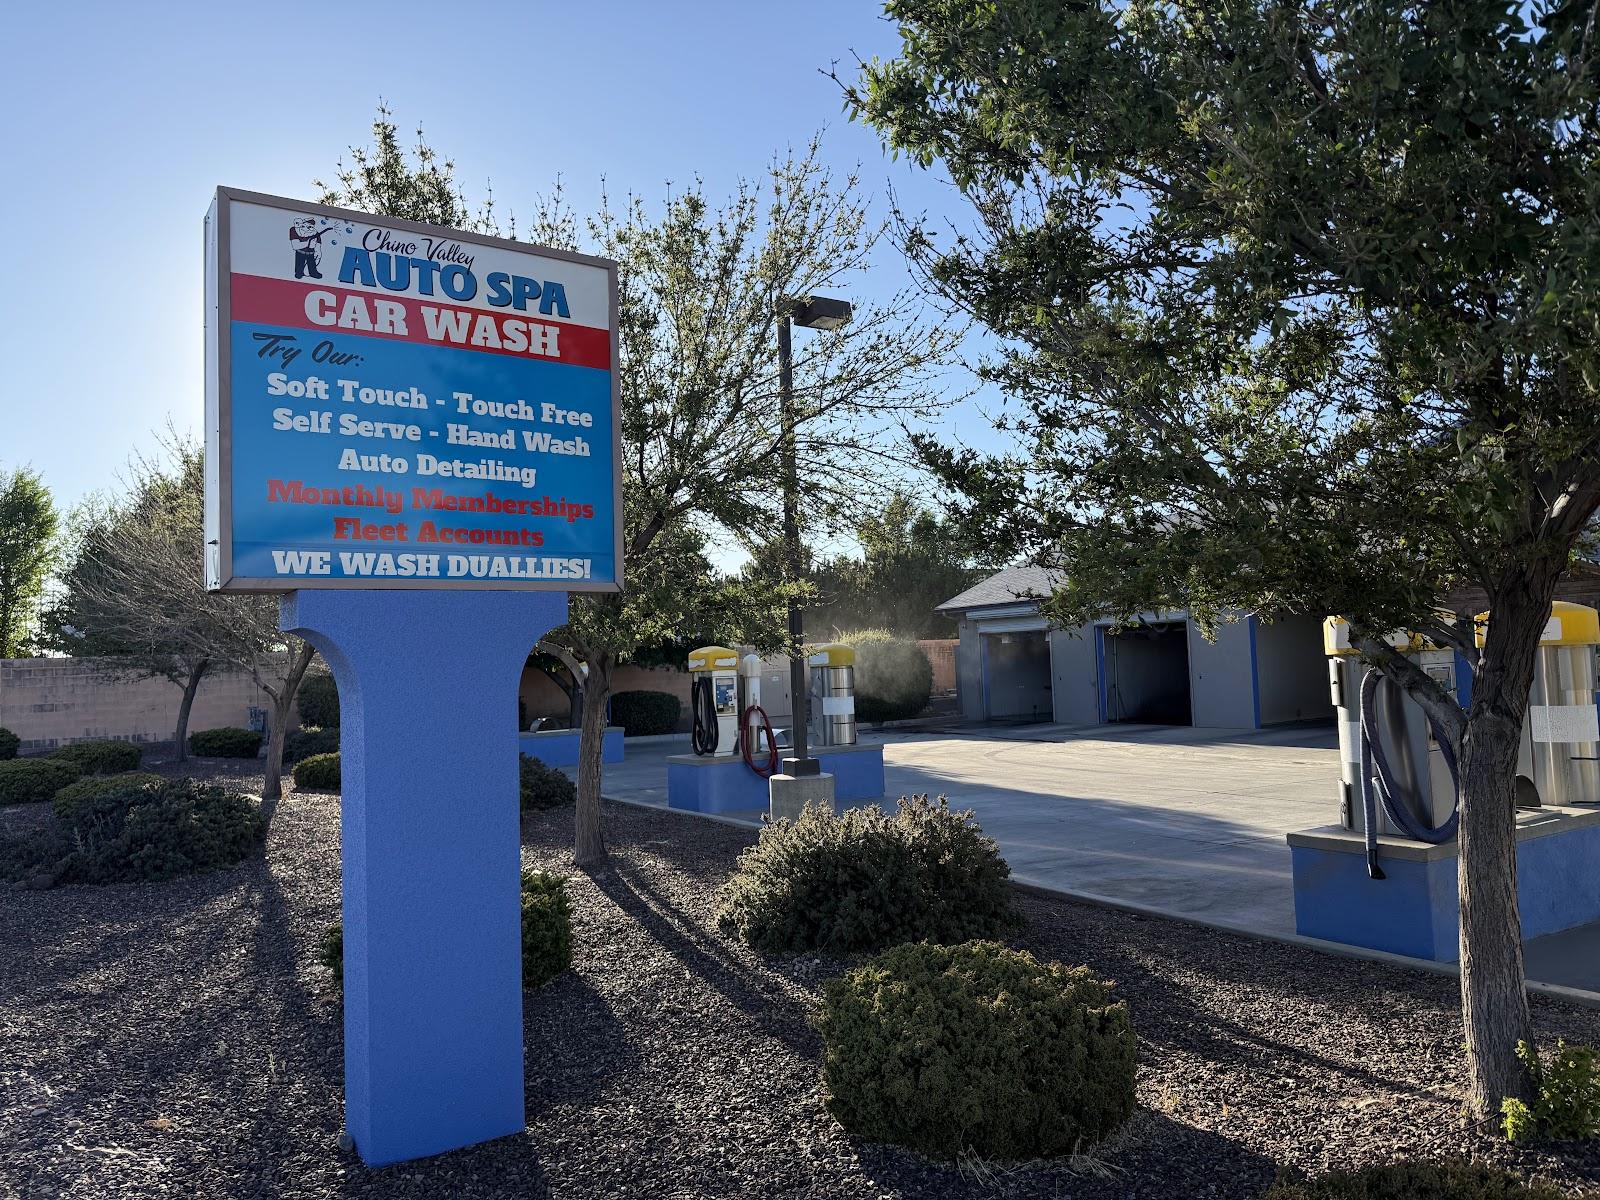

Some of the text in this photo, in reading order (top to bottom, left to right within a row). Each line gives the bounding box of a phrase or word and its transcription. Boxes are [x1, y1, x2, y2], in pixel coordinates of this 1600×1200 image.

[362, 228, 475, 273] Chino Valley
[338, 247, 570, 319] AUTO SPA
[305, 291, 560, 358] CAR WASH
[253, 333, 364, 369] Try Our:
[267, 373, 329, 400] Soft
[338, 380, 428, 409] Touch
[453, 392, 534, 422] Touch
[540, 403, 592, 427] Free
[273, 408, 332, 434] Self
[340, 415, 421, 441] Serve
[447, 423, 515, 450] Hand
[523, 432, 591, 457] Wash
[338, 449, 536, 488] Auto Detailing
[267, 480, 593, 522] Monthly Memberships
[333, 517, 544, 547] Fleet Accounts
[272, 551, 591, 579] WE WASH DUALLIES!
